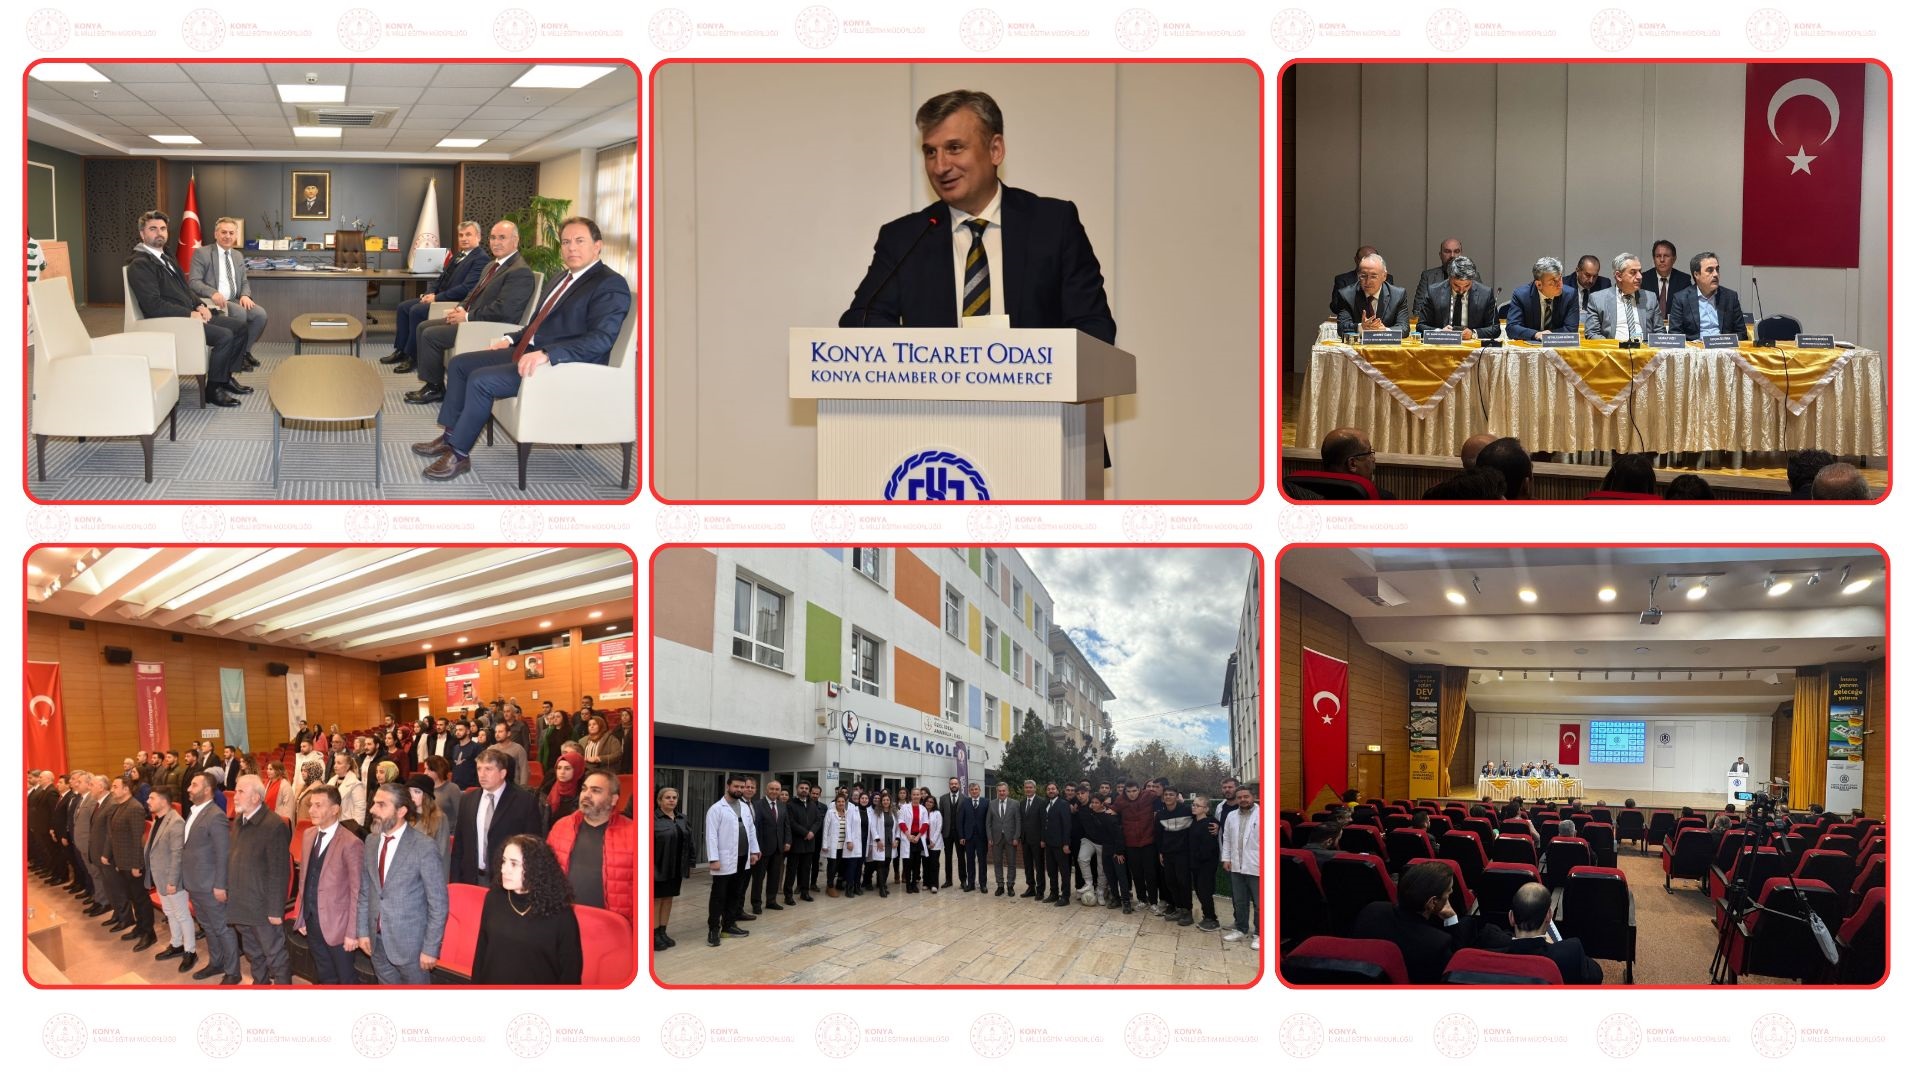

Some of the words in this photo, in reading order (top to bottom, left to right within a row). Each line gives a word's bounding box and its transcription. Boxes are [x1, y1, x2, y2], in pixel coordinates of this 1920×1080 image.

[811, 370, 861, 383] KONYA
[865, 371, 938, 384] CHAMBER
[942, 372, 961, 384] OF
[1416, 688, 1433, 696] DEV
[866, 723, 921, 752] İDEAL
[925, 740, 970, 760] KOLEİ
